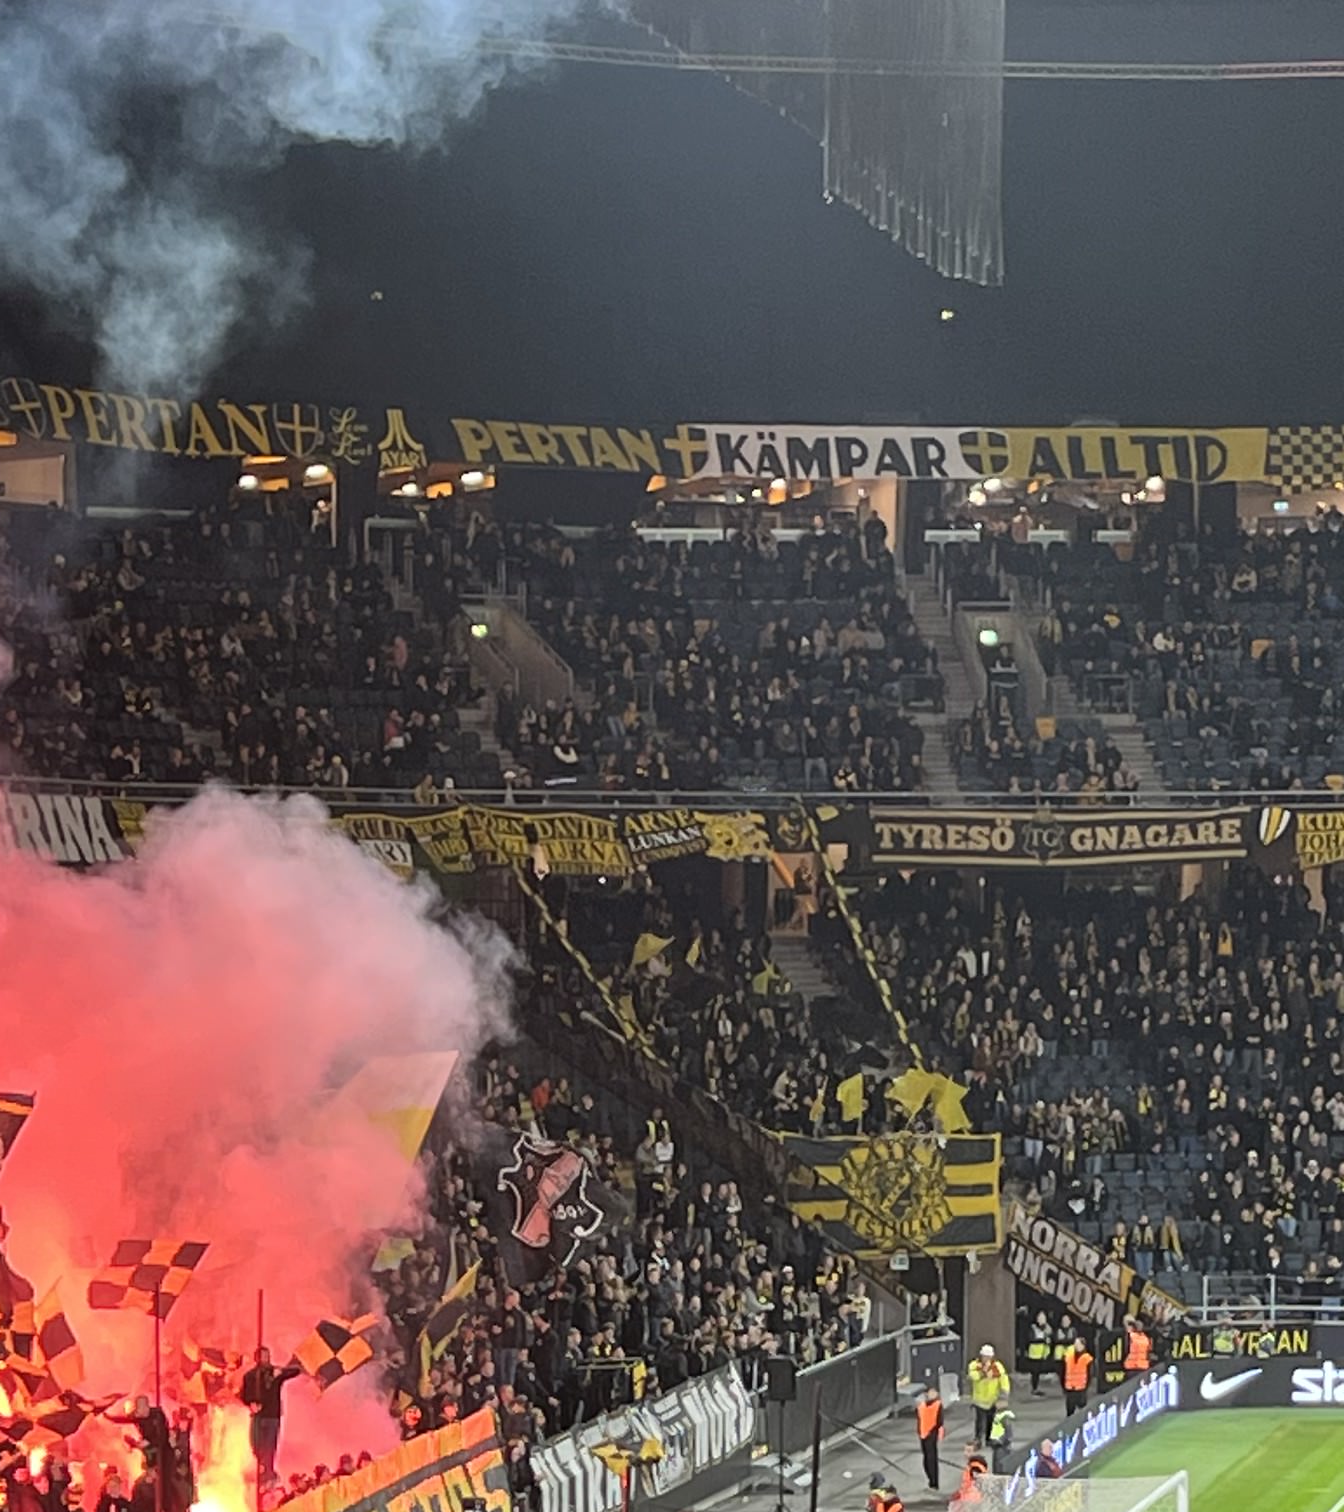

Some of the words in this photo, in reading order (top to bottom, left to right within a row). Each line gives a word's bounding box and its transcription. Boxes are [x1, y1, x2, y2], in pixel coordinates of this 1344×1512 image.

[39, 384, 277, 458] PERTAN
[451, 417, 659, 471] PERTAN
[719, 430, 948, 481] KÄMPAR
[1027, 432, 1230, 481] ALLTID
[628, 824, 702, 852] LUNKAN
[875, 817, 1015, 852] TYRESÖ
[1069, 818, 1242, 853] GNAGARE
[1010, 1202, 1123, 1296] NORRA
[1007, 1239, 1116, 1331] UNGDOM
